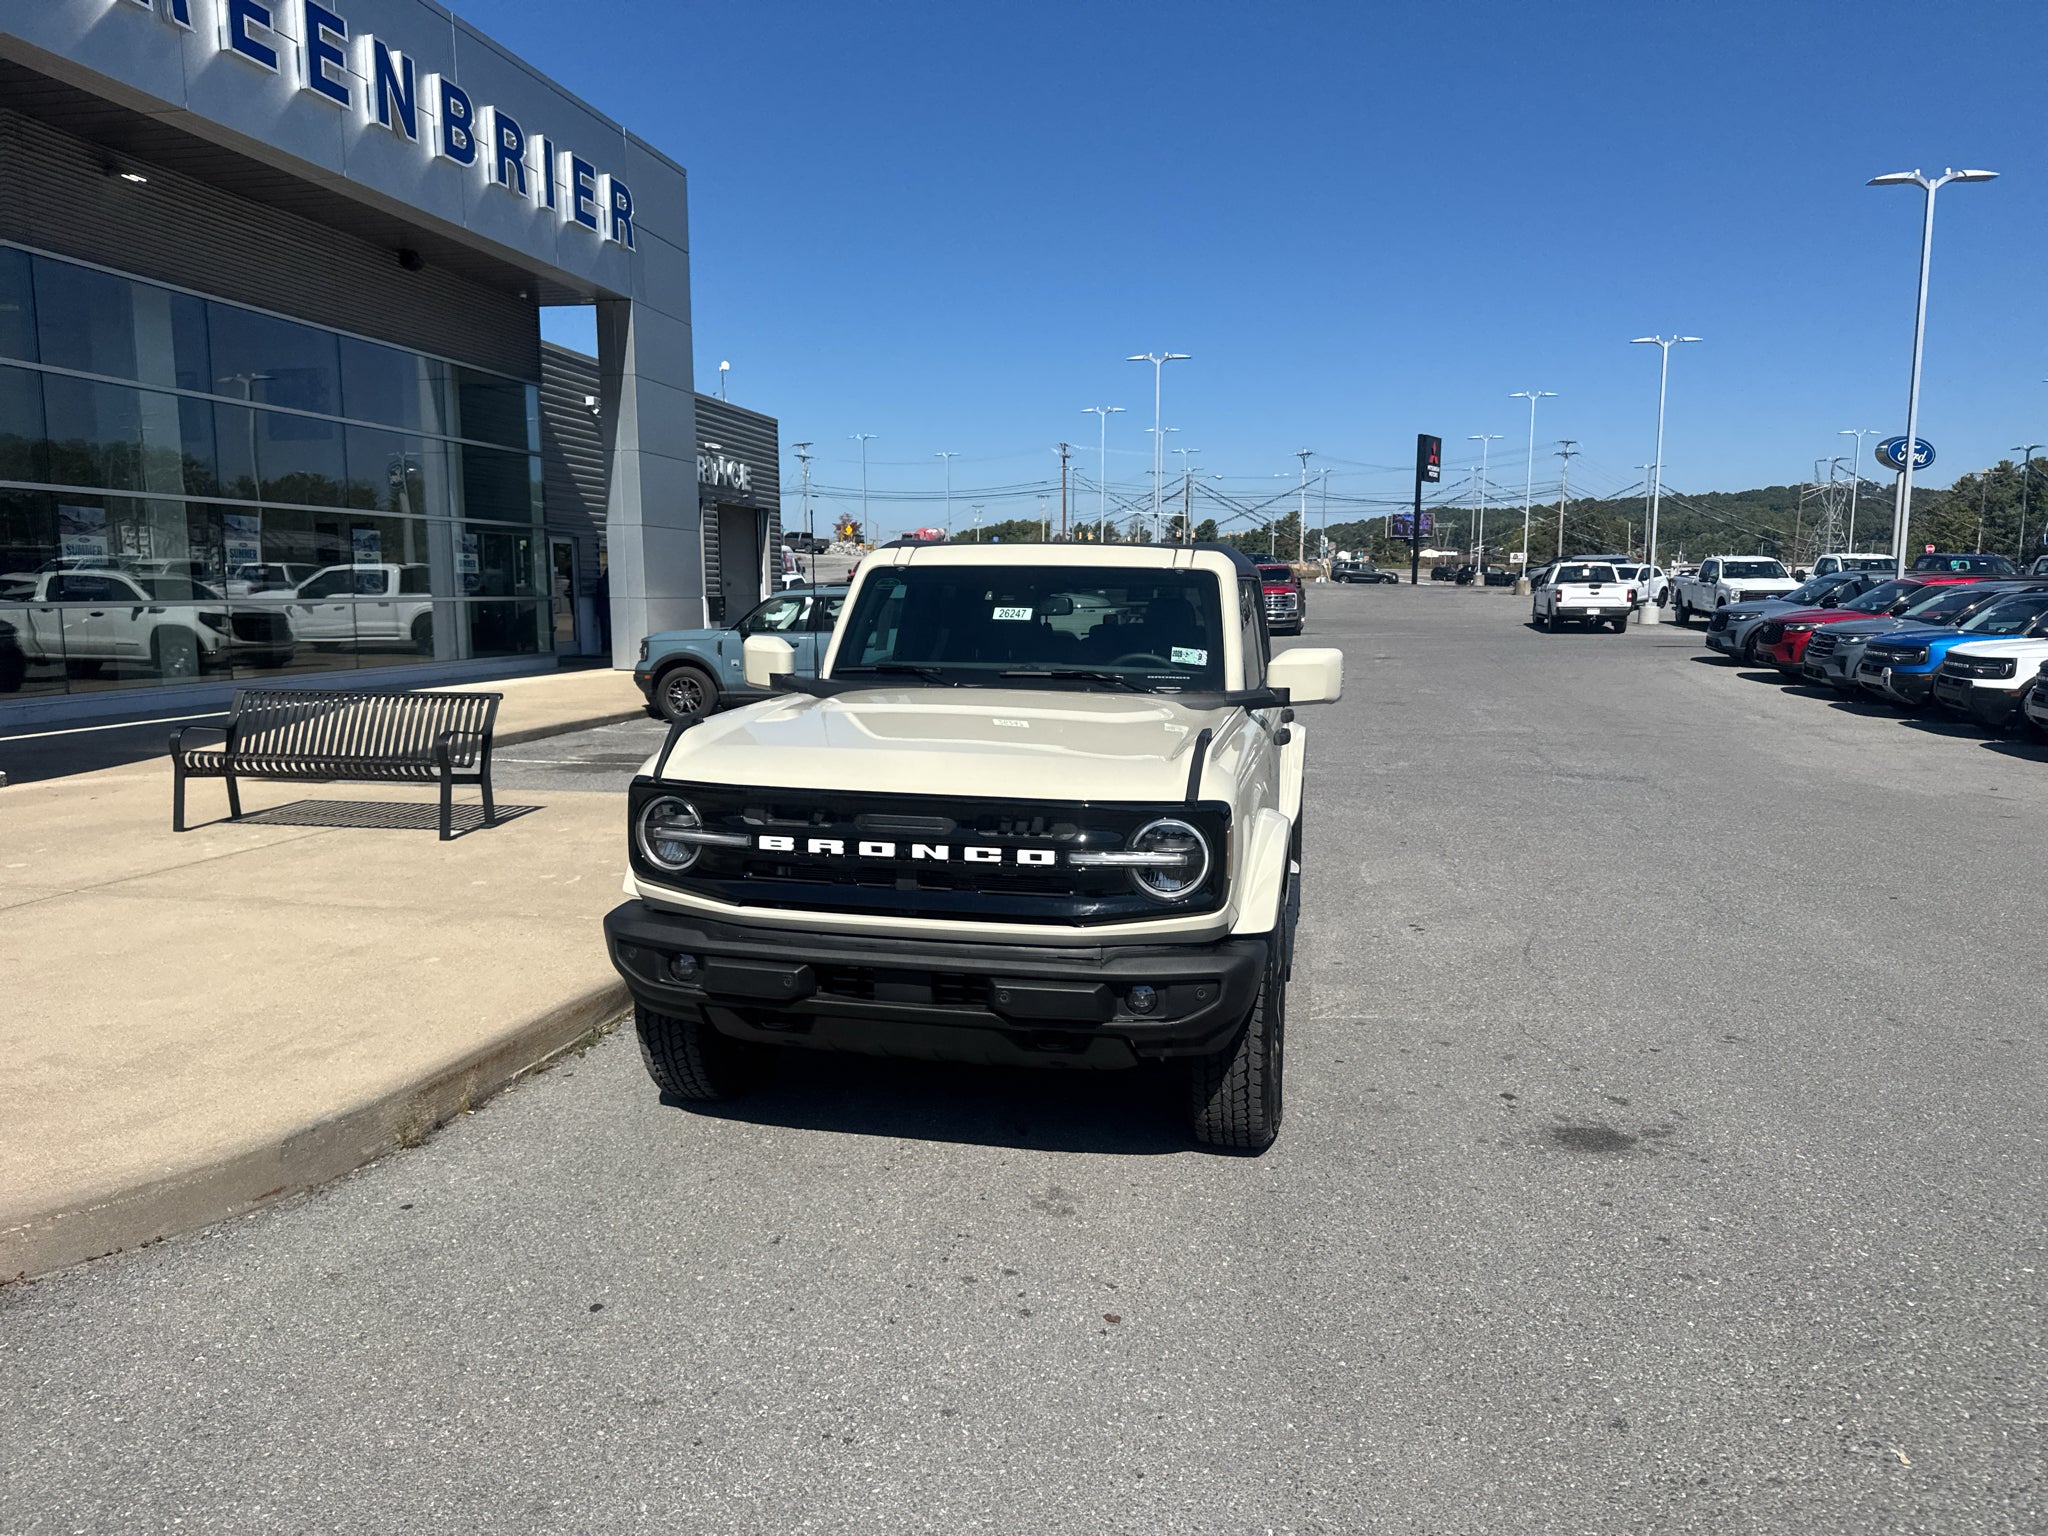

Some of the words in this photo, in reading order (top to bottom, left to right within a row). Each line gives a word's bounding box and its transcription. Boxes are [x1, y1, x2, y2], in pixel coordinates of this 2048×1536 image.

[122, 0, 636, 253] EENBRIER
[66, 544, 103, 556] SUMMER
[229, 548, 258, 559] SUMMER
[998, 609, 1027, 618] 26247
[758, 835, 1056, 865] BRONCO
